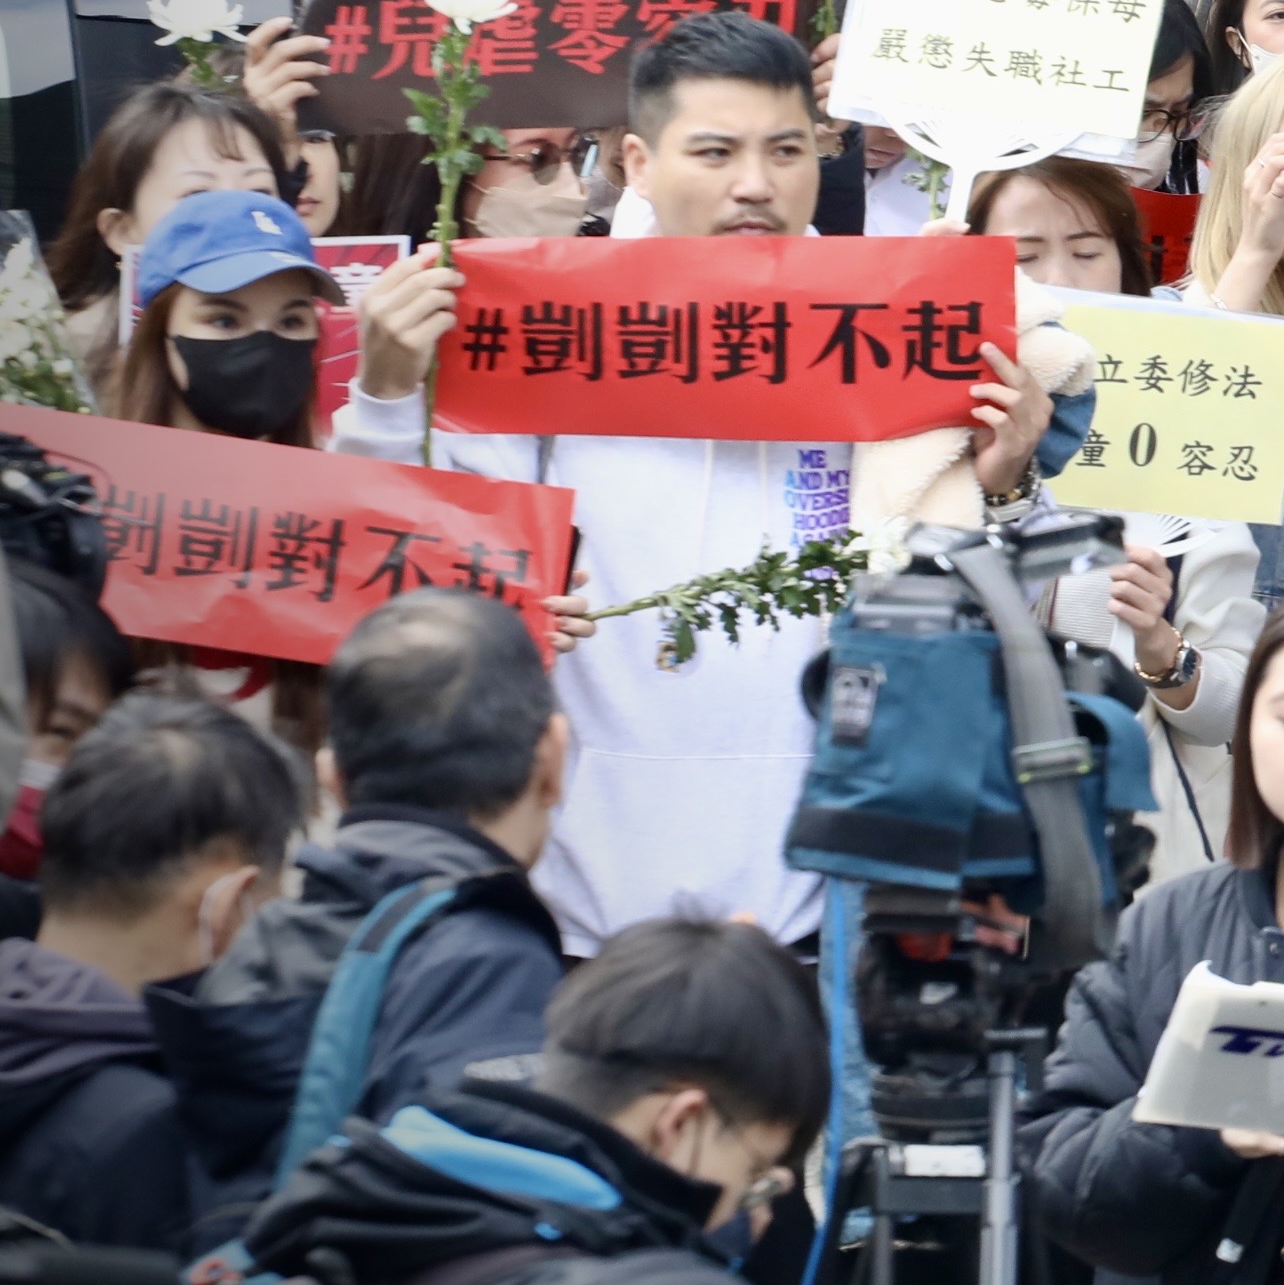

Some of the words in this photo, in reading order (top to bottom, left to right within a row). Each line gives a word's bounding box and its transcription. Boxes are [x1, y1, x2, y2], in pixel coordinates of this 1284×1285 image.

[871, 27, 1130, 93] 嚴懲失職社工
[463, 299, 985, 384] #剴剴對不起
[1094, 354, 1263, 400] 立委修法
[798, 449, 826, 468] ME
